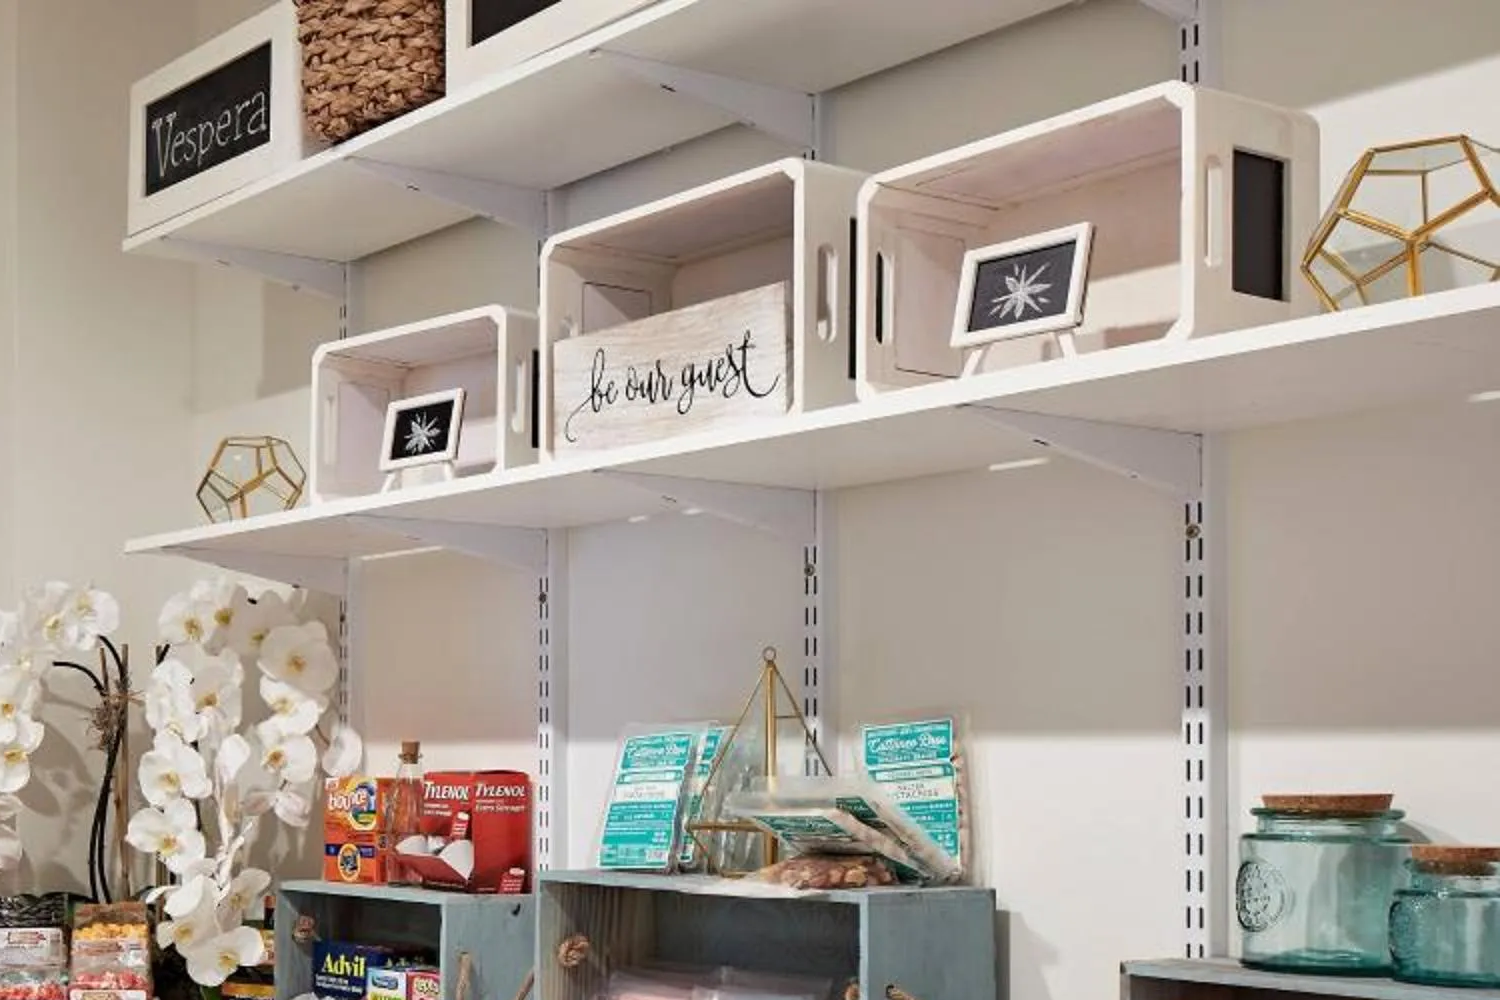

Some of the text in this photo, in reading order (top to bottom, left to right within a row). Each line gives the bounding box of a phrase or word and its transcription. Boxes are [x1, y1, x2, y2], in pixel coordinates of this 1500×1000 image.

[151, 90, 268, 177] Vespera
[565, 329, 780, 442] be our guest
[423, 781, 470, 799] TYLENOL
[475, 782, 526, 797] TYLENOL
[322, 953, 367, 978] Advil
